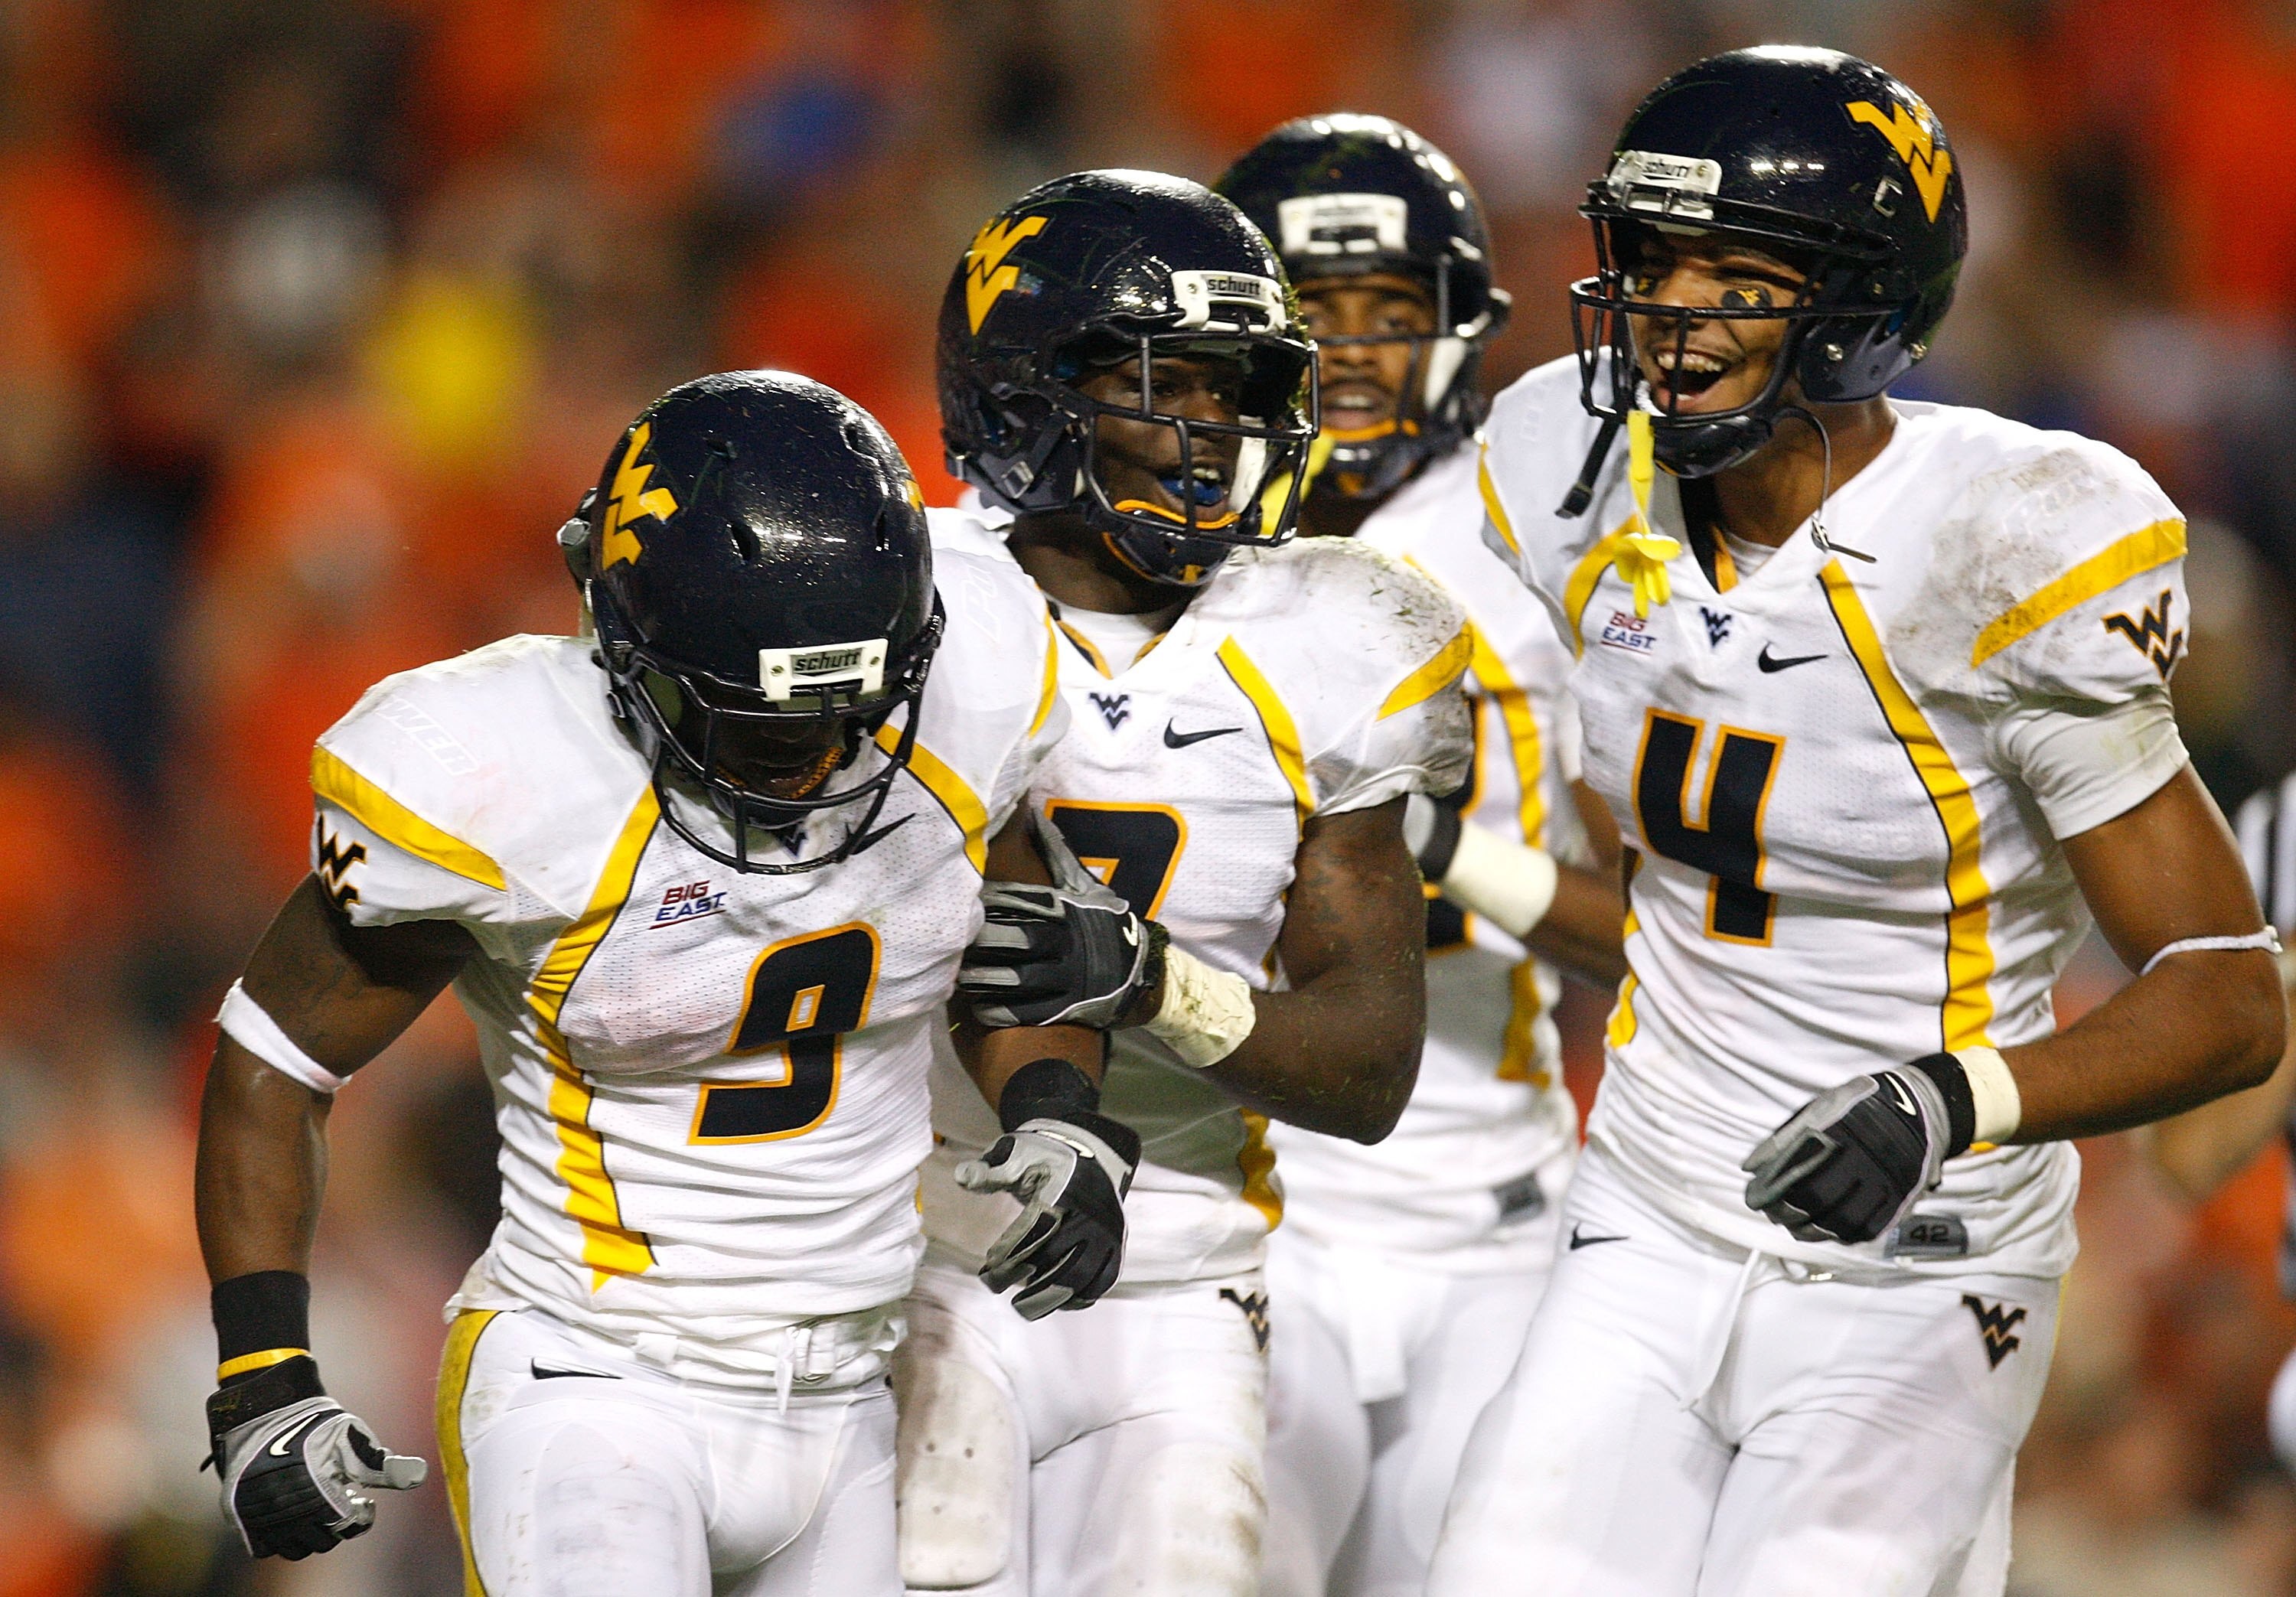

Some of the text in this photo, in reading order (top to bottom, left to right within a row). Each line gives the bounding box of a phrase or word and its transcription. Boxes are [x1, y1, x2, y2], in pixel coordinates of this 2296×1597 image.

[1208, 277, 1261, 295] schutt
[1609, 611, 1647, 632] BIG
[1602, 626, 1656, 649] EAST
[794, 652, 859, 672] schutt
[1631, 706, 1787, 947] 4
[661, 880, 710, 904] BIG
[655, 892, 727, 921] EAST
[687, 920, 882, 1146] 9
[1910, 1224, 1949, 1241] 42
